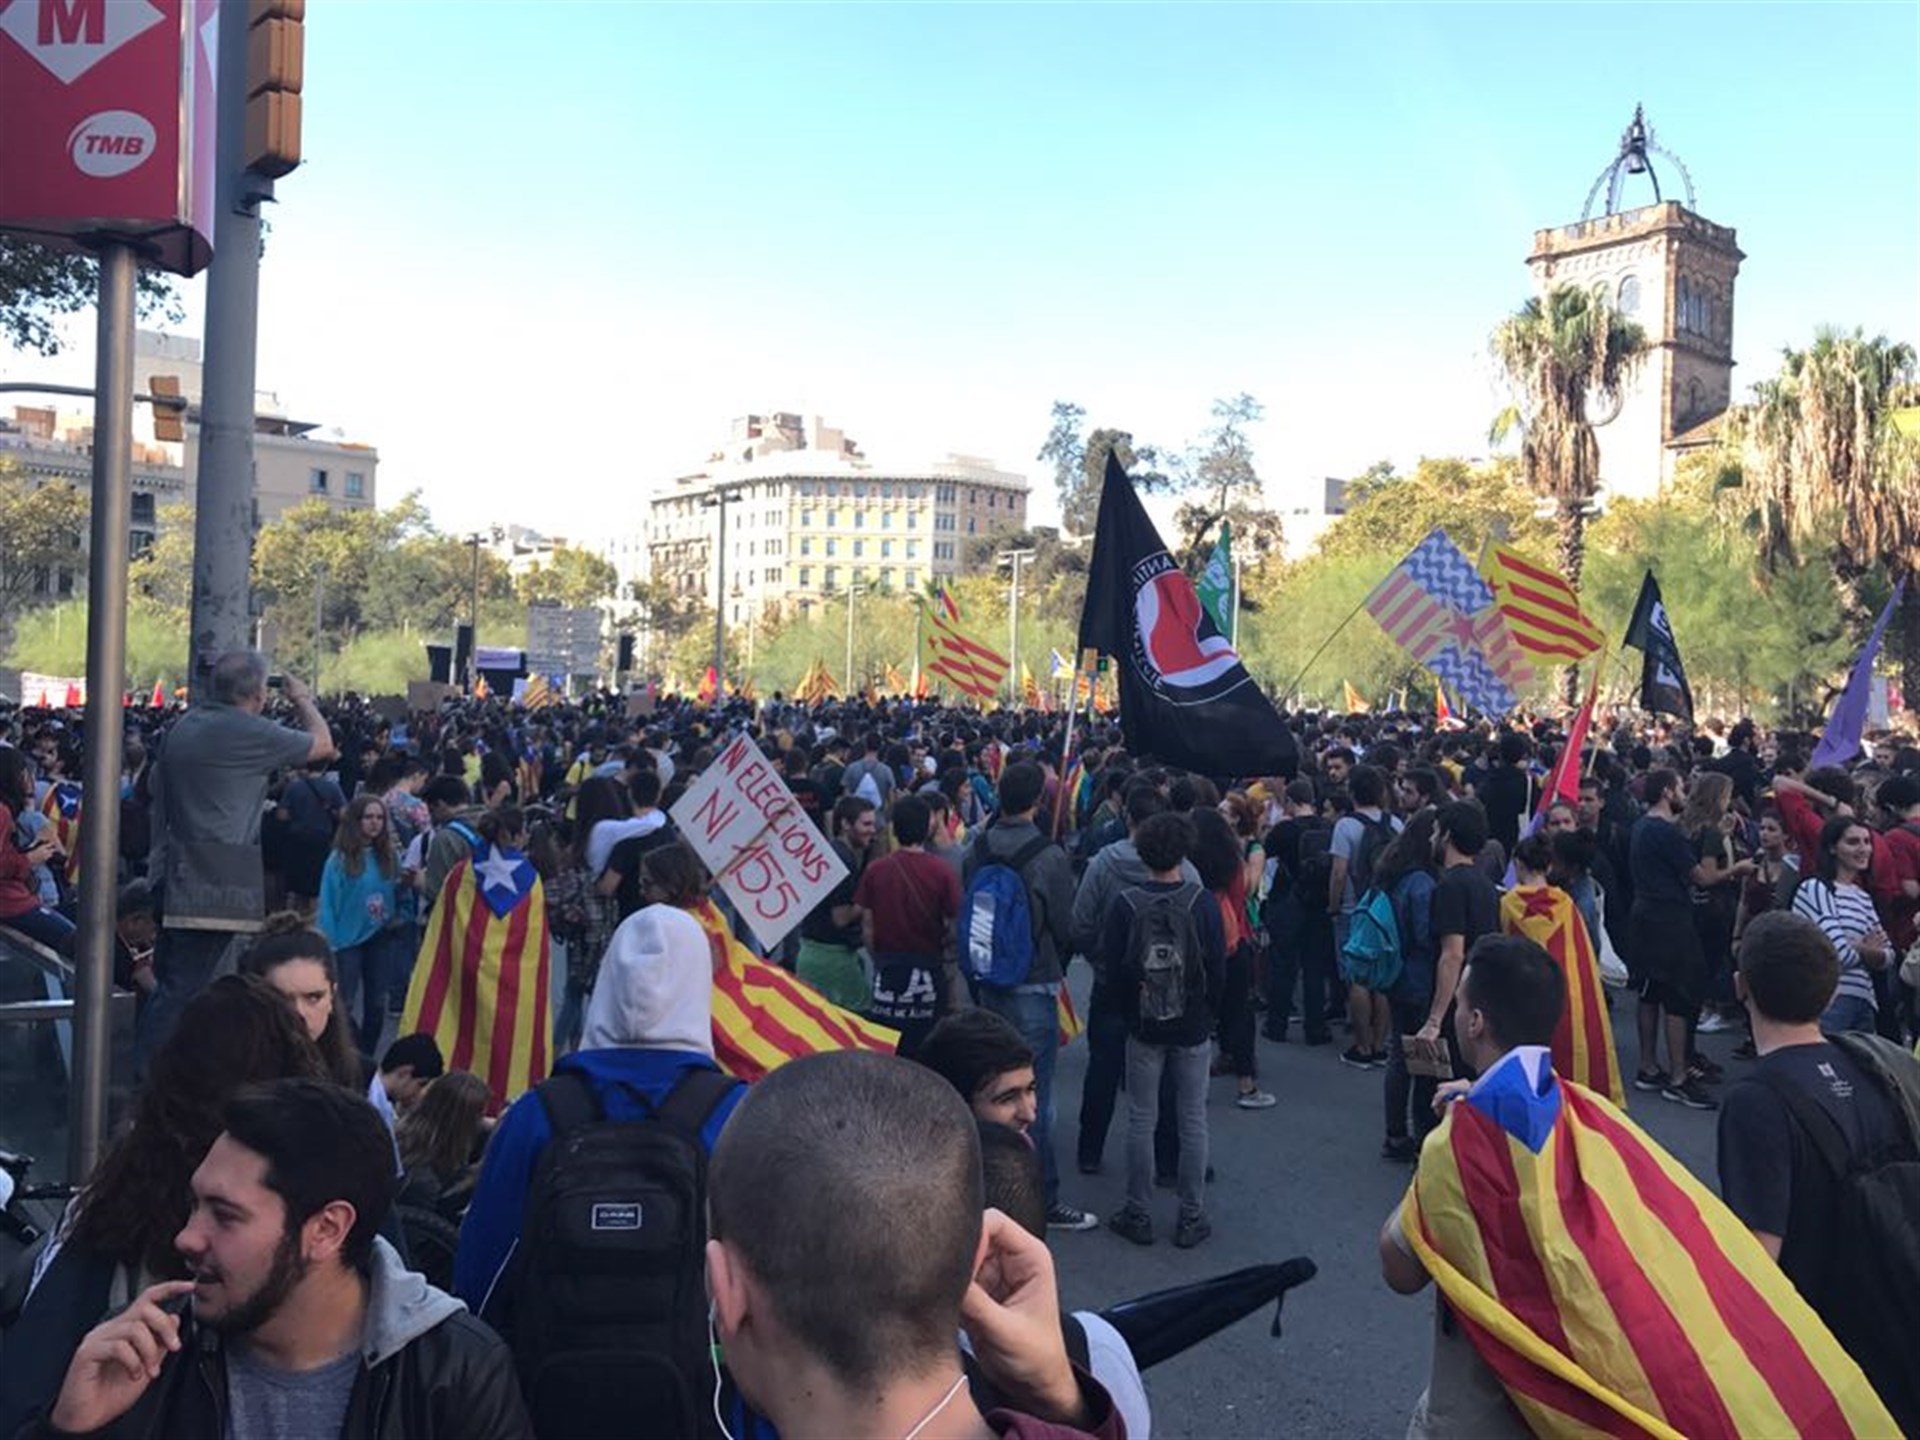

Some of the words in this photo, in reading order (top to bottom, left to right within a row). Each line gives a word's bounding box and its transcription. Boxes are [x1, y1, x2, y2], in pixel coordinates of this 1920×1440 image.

[37, 0, 105, 46] M
[84, 134, 145, 156] TMB
[690, 787, 741, 844] NI
[728, 841, 801, 920] 155
[968, 904, 995, 964] NIKE
